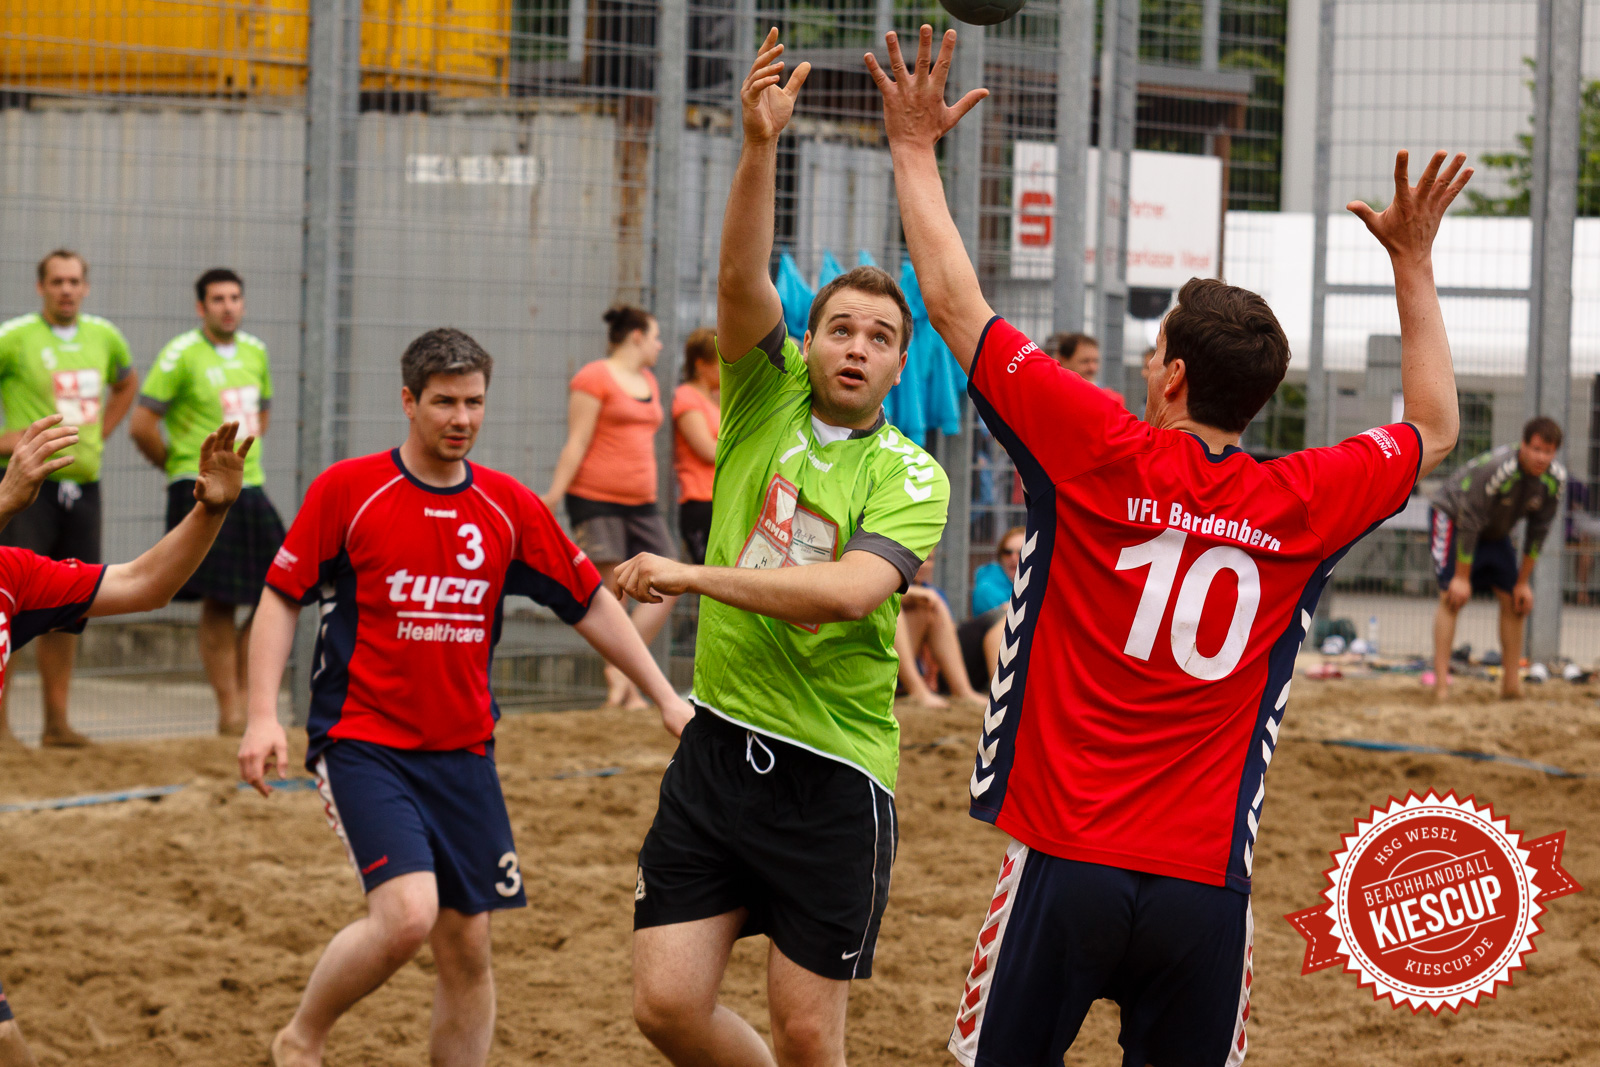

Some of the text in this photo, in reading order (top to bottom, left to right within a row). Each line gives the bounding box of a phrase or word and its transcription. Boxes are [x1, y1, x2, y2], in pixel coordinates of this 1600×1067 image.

[1127, 497, 1161, 524] VFL
[456, 523, 486, 571] 3
[385, 568, 491, 611] tyco
[1114, 527, 1261, 681] 10
[396, 621, 486, 644] Healthcare
[495, 851, 521, 898] 3
